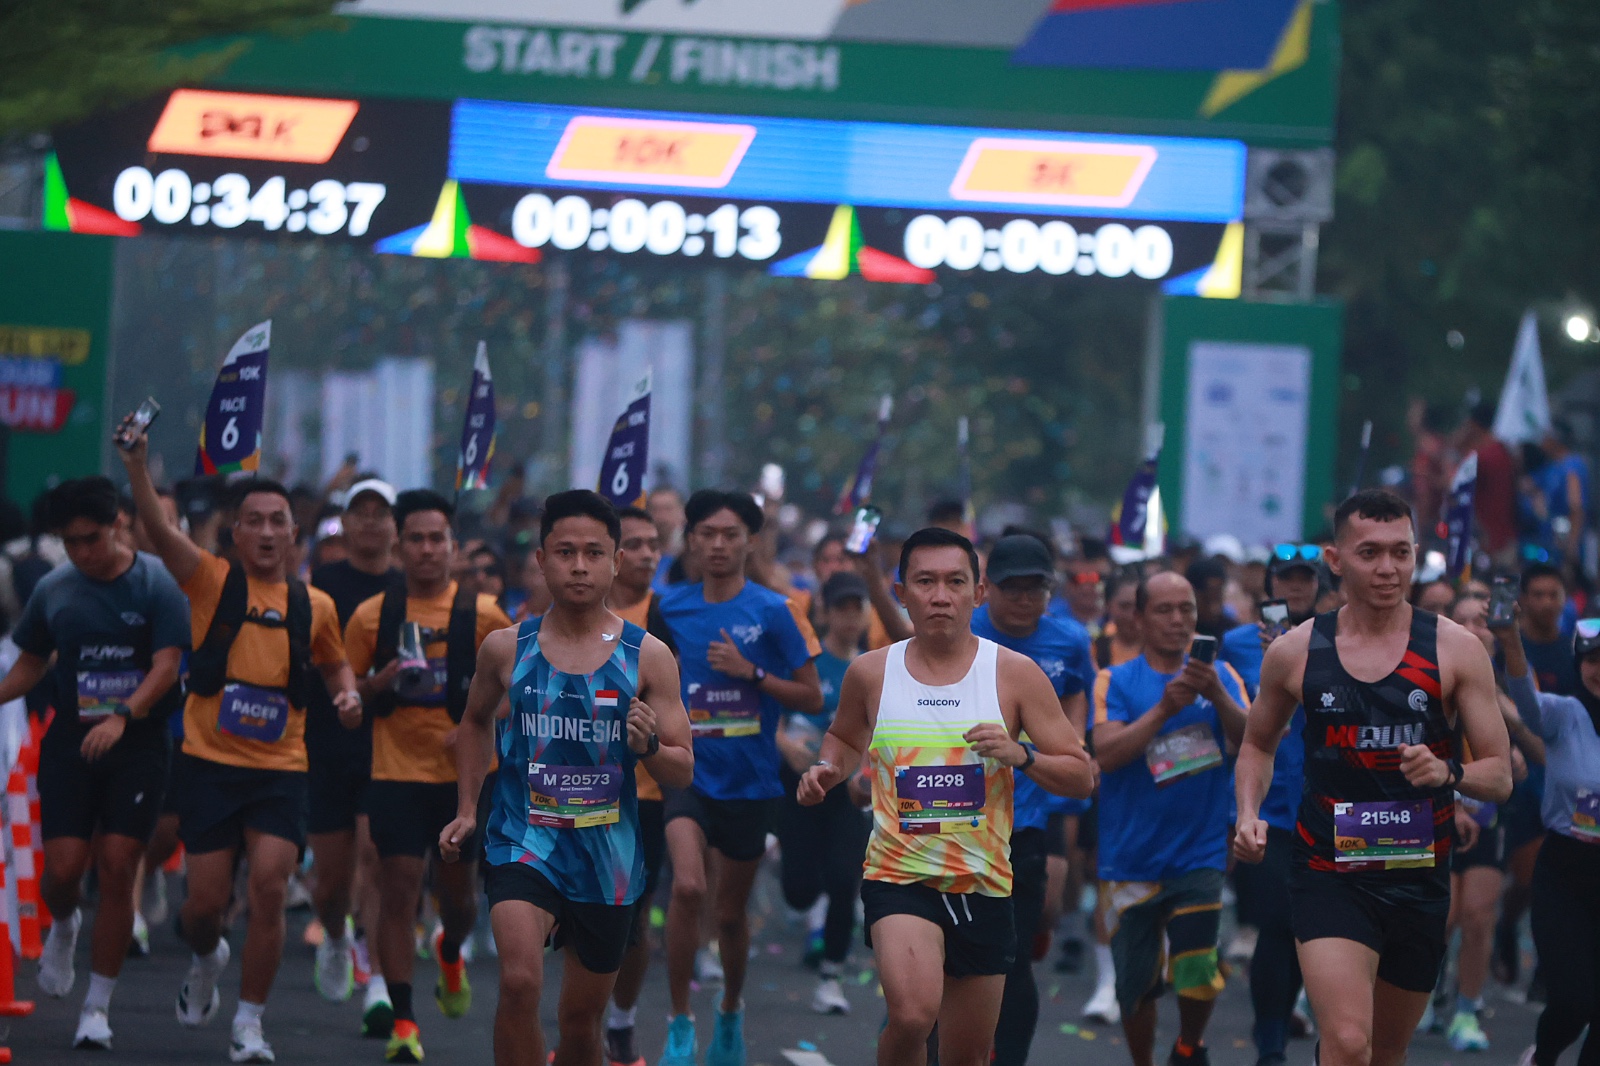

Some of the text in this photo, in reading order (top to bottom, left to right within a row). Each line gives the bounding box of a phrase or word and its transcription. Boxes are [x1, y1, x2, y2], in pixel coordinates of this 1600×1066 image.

[464, 26, 840, 91] START / FINISH
[113, 166, 387, 237] 00:34:37
[512, 193, 782, 260] 00:00:13
[904, 214, 1174, 280] 00:00:00
[221, 416, 240, 451] 6
[465, 432, 478, 466] 6
[611, 461, 629, 496] 6
[231, 698, 279, 720] PACER
[917, 698, 961, 707] saucony
[521, 711, 621, 743] INDONESIA
[543, 773, 610, 786] M 20573
[917, 773, 964, 788] 21298
[534, 795, 551, 805] 10K
[900, 801, 915, 811] 10K
[1361, 810, 1411, 826] 21548
[1339, 839, 1361, 849] 10K
